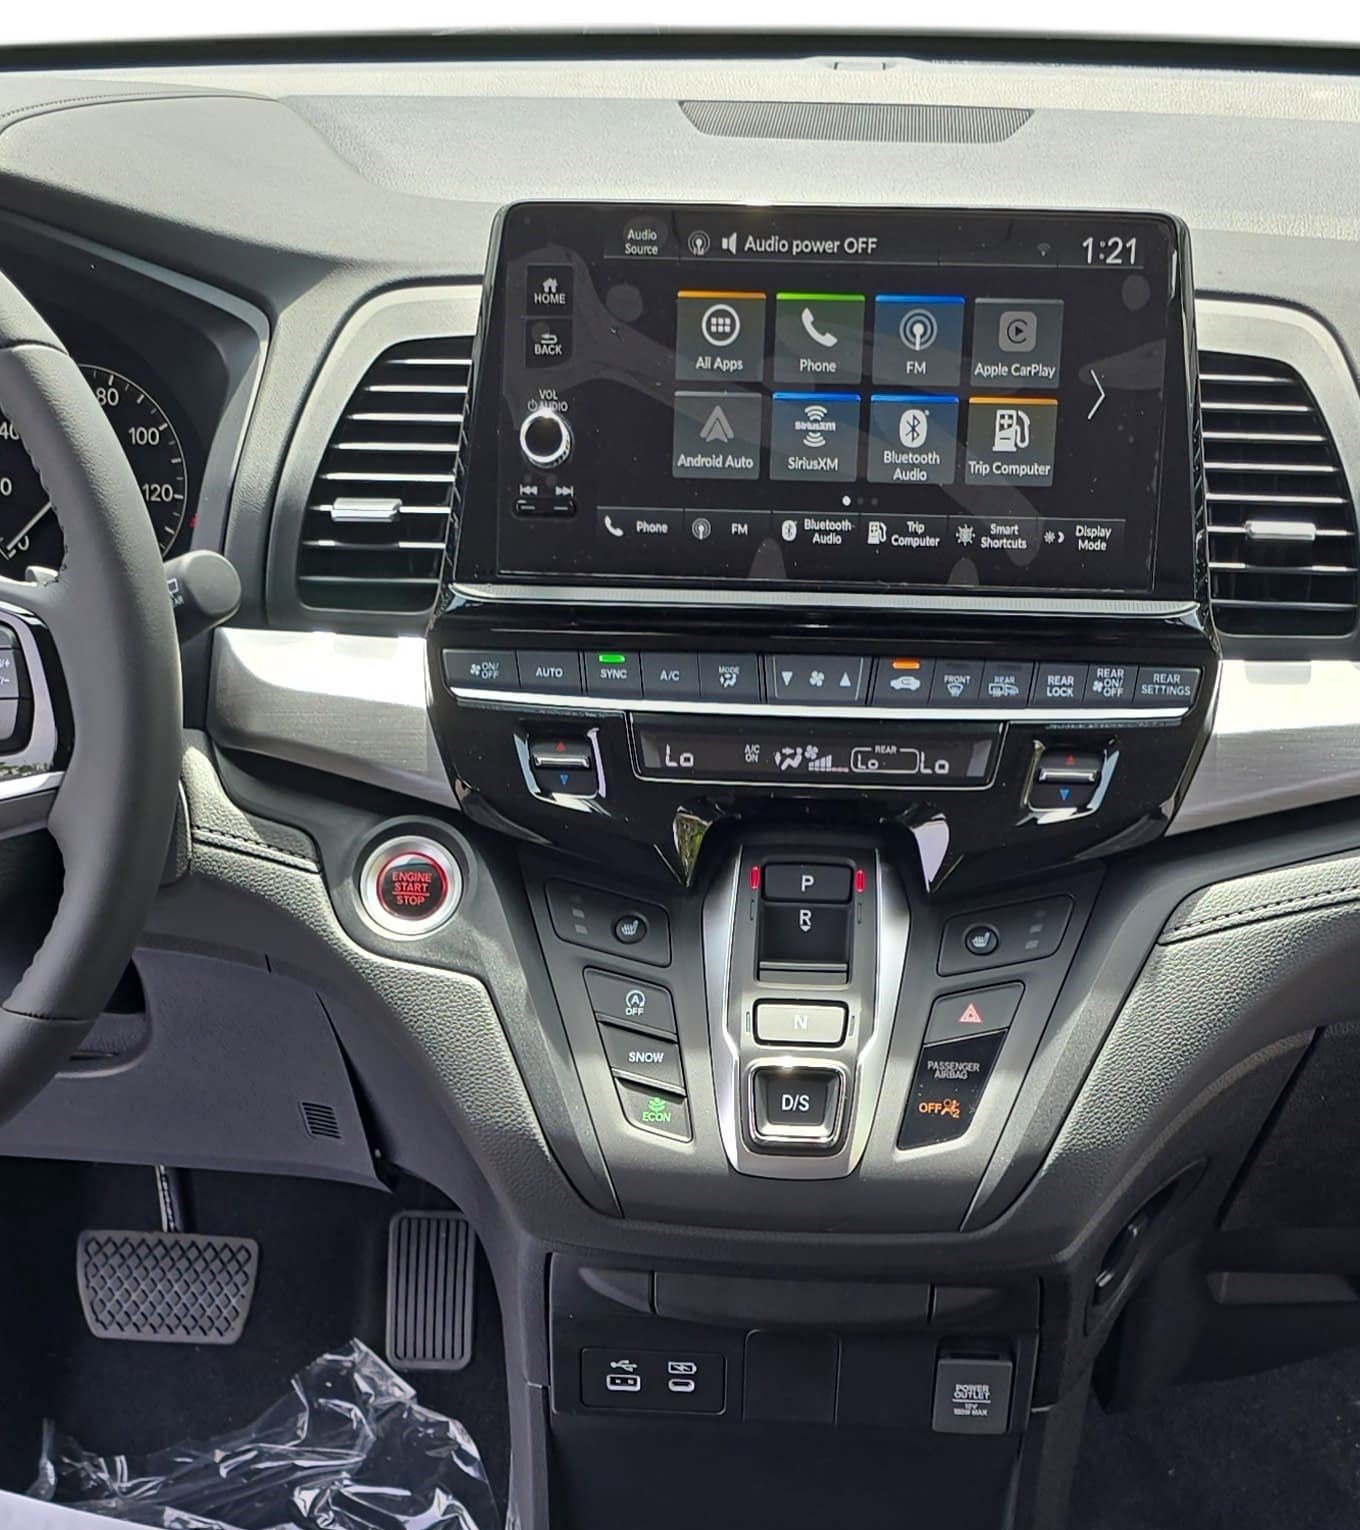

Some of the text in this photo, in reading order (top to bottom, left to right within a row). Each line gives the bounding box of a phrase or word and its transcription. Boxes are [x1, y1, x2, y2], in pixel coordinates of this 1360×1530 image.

[627, 229, 657, 241] Audio
[624, 243, 658, 255] Source
[744, 235, 877, 256] Audio power OFF
[1082, 236, 1137, 264] 1:21
[534, 293, 566, 304] HOME
[534, 344, 562, 355] BACK
[695, 357, 743, 372] All Apps
[799, 359, 837, 372] Phone
[905, 361, 927, 374] FM
[974, 363, 1056, 379] Apple CarPlay
[95, 388, 119, 406] 80
[539, 389, 558, 400] VOL
[128, 427, 160, 445] 100
[677, 454, 754, 469] Android Auto
[788, 457, 838, 471] SiriusXM
[883, 451, 940, 465] Bluetooth
[893, 468, 927, 481] Audio
[968, 462, 1051, 478] Trip Computer
[142, 484, 174, 502] 120
[636, 521, 668, 534] Phone
[731, 523, 748, 536] FM
[804, 518, 852, 532] Bluetooth
[907, 521, 925, 535] Trip
[990, 524, 1019, 537] Smart
[1075, 525, 1112, 540] Display
[812, 533, 842, 545] Audio
[891, 535, 940, 549] Computer
[980, 537, 1027, 550] Shortcuts
[1078, 540, 1107, 551] Mode
[535, 667, 563, 678] AUTO
[600, 668, 627, 679] SYNC
[660, 670, 681, 681] A/C
[718, 666, 740, 674] MODE
[1096, 668, 1124, 679] REAR
[943, 675, 971, 685] FRONT
[994, 676, 1016, 684] REAR
[1047, 675, 1075, 687] REAR
[1103, 678, 1124, 689] ON/
[1153, 673, 1181, 684] REAR
[1046, 686, 1074, 698] LOCK
[1103, 687, 1124, 698] OFF
[1141, 684, 1191, 697] SETTINGS
[874, 745, 897, 754] REAR
[745, 754, 759, 762] ON
[392, 871, 432, 882] ENGINE
[394, 882, 429, 892] START
[801, 875, 815, 892] P
[396, 896, 425, 905] STOP
[799, 909, 812, 925] R
[794, 1015, 808, 1030] N
[628, 1052, 664, 1062] SNOW
[927, 1061, 980, 1072] PASSENGER
[934, 1070, 968, 1079] AIRBAG
[781, 1094, 810, 1111] D/S
[918, 1102, 942, 1113] OFF
[642, 1112, 671, 1122] ECON
[955, 1384, 989, 1392] POWER
[953, 1391, 990, 1400] OUTLET
